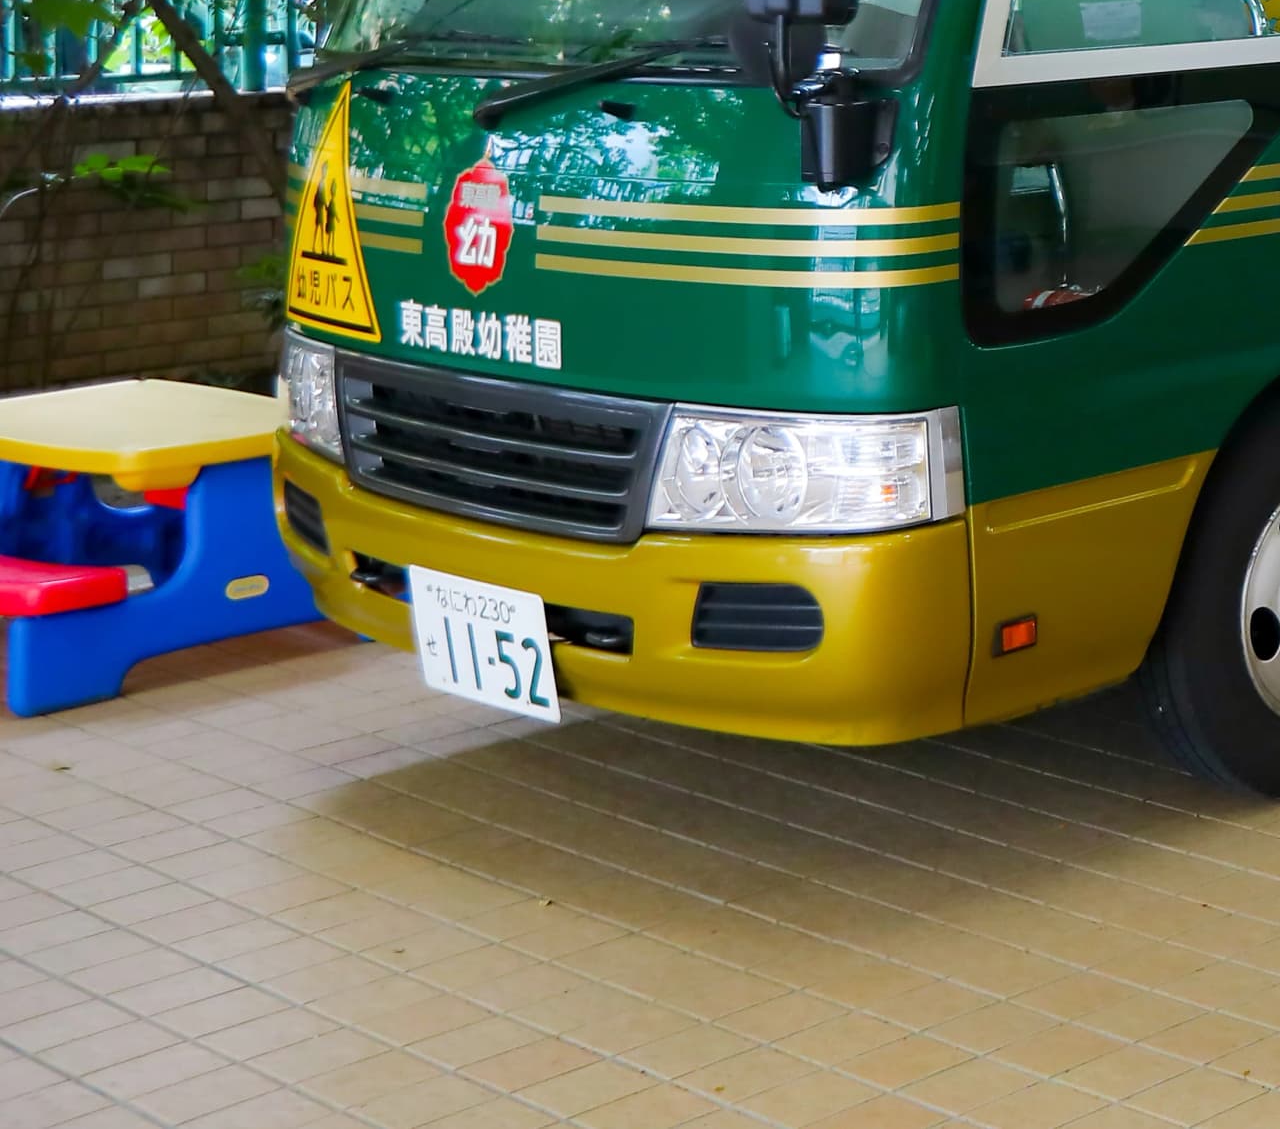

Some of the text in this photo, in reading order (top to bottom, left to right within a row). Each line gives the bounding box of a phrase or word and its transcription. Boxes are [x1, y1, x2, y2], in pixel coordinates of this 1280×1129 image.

[455, 217, 497, 268] 幼
[296, 270, 355, 312] 幼児バス
[400, 299, 562, 369] 東高殿幼稚園
[427, 635, 437, 656] せ
